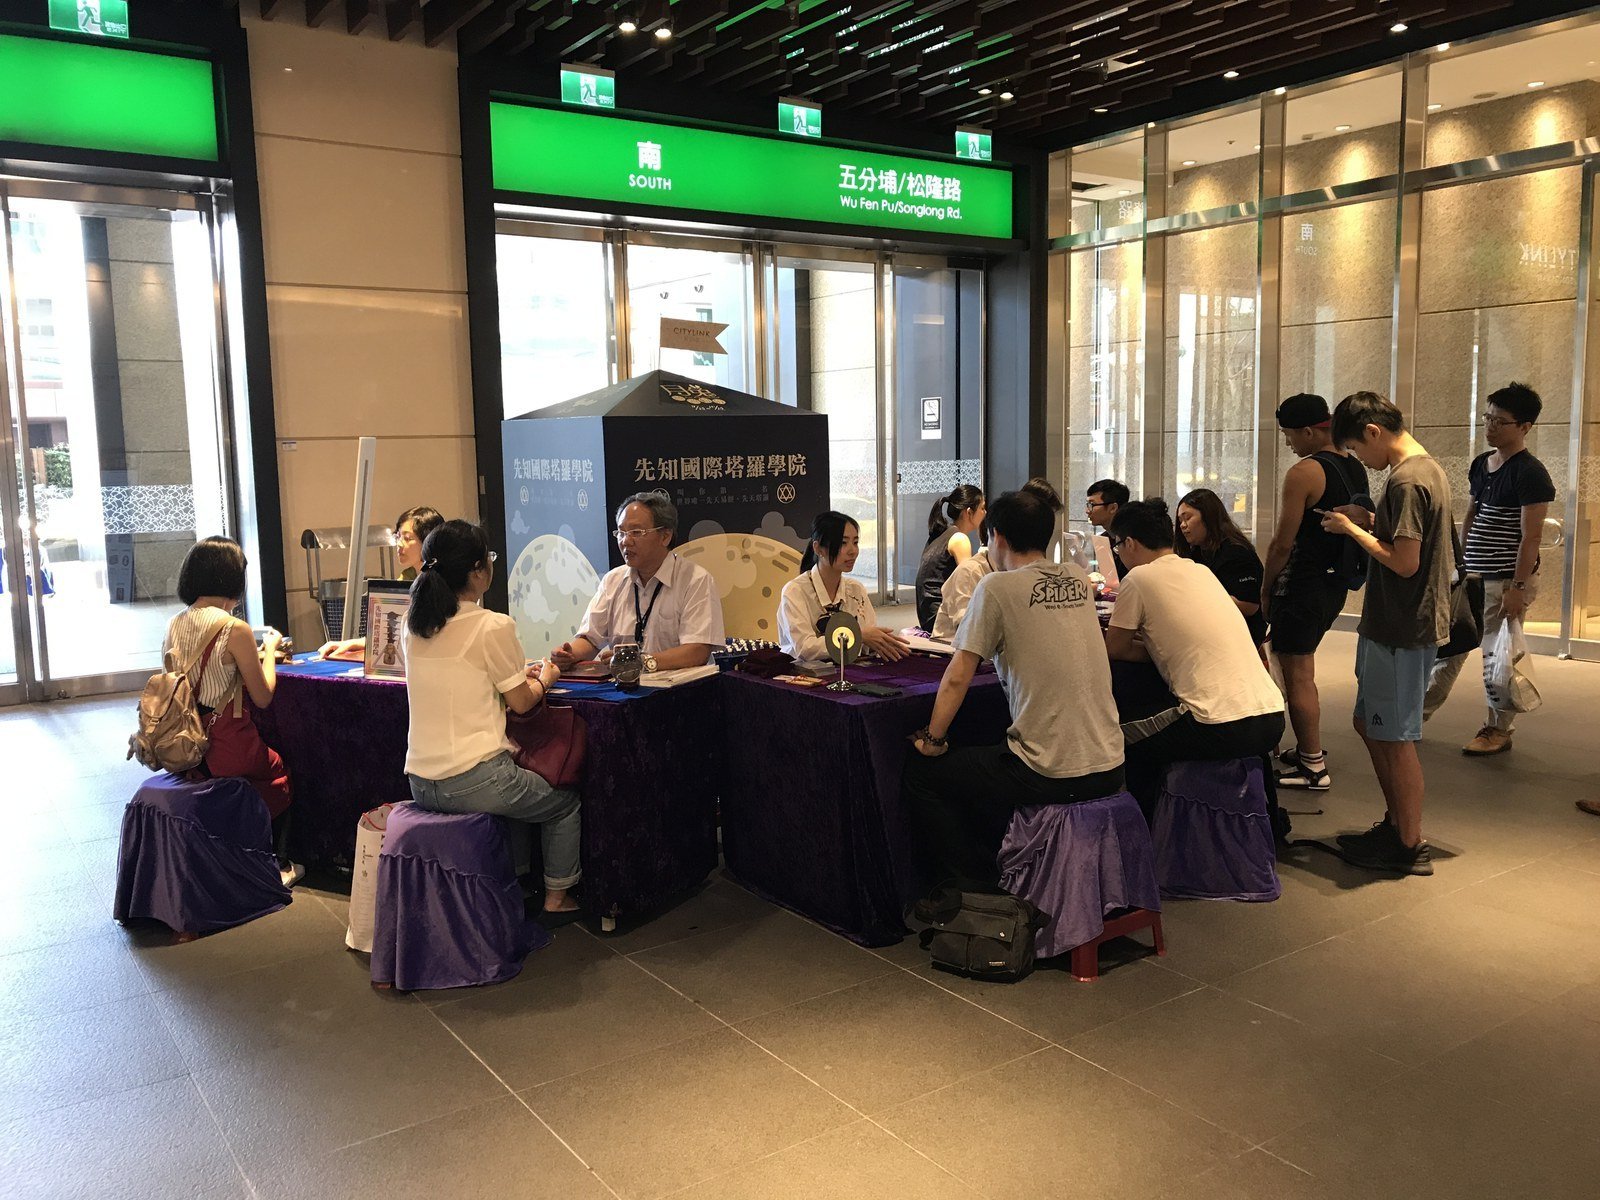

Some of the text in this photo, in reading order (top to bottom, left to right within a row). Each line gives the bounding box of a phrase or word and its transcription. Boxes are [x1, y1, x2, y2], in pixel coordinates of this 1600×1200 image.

[636, 140, 662, 170] 南
[628, 173, 672, 191] SOUTH
[838, 164, 962, 202] 五分埔/松隆路
[840, 194, 963, 220] Wu Fen Pu/Songlong Rd.
[673, 326, 711, 337] CITYLINK
[514, 457, 594, 483] 先知國際塔羅學院
[633, 453, 807, 483] 先知國際塔羅學院
[1029, 578, 1088, 608] SPIDER
